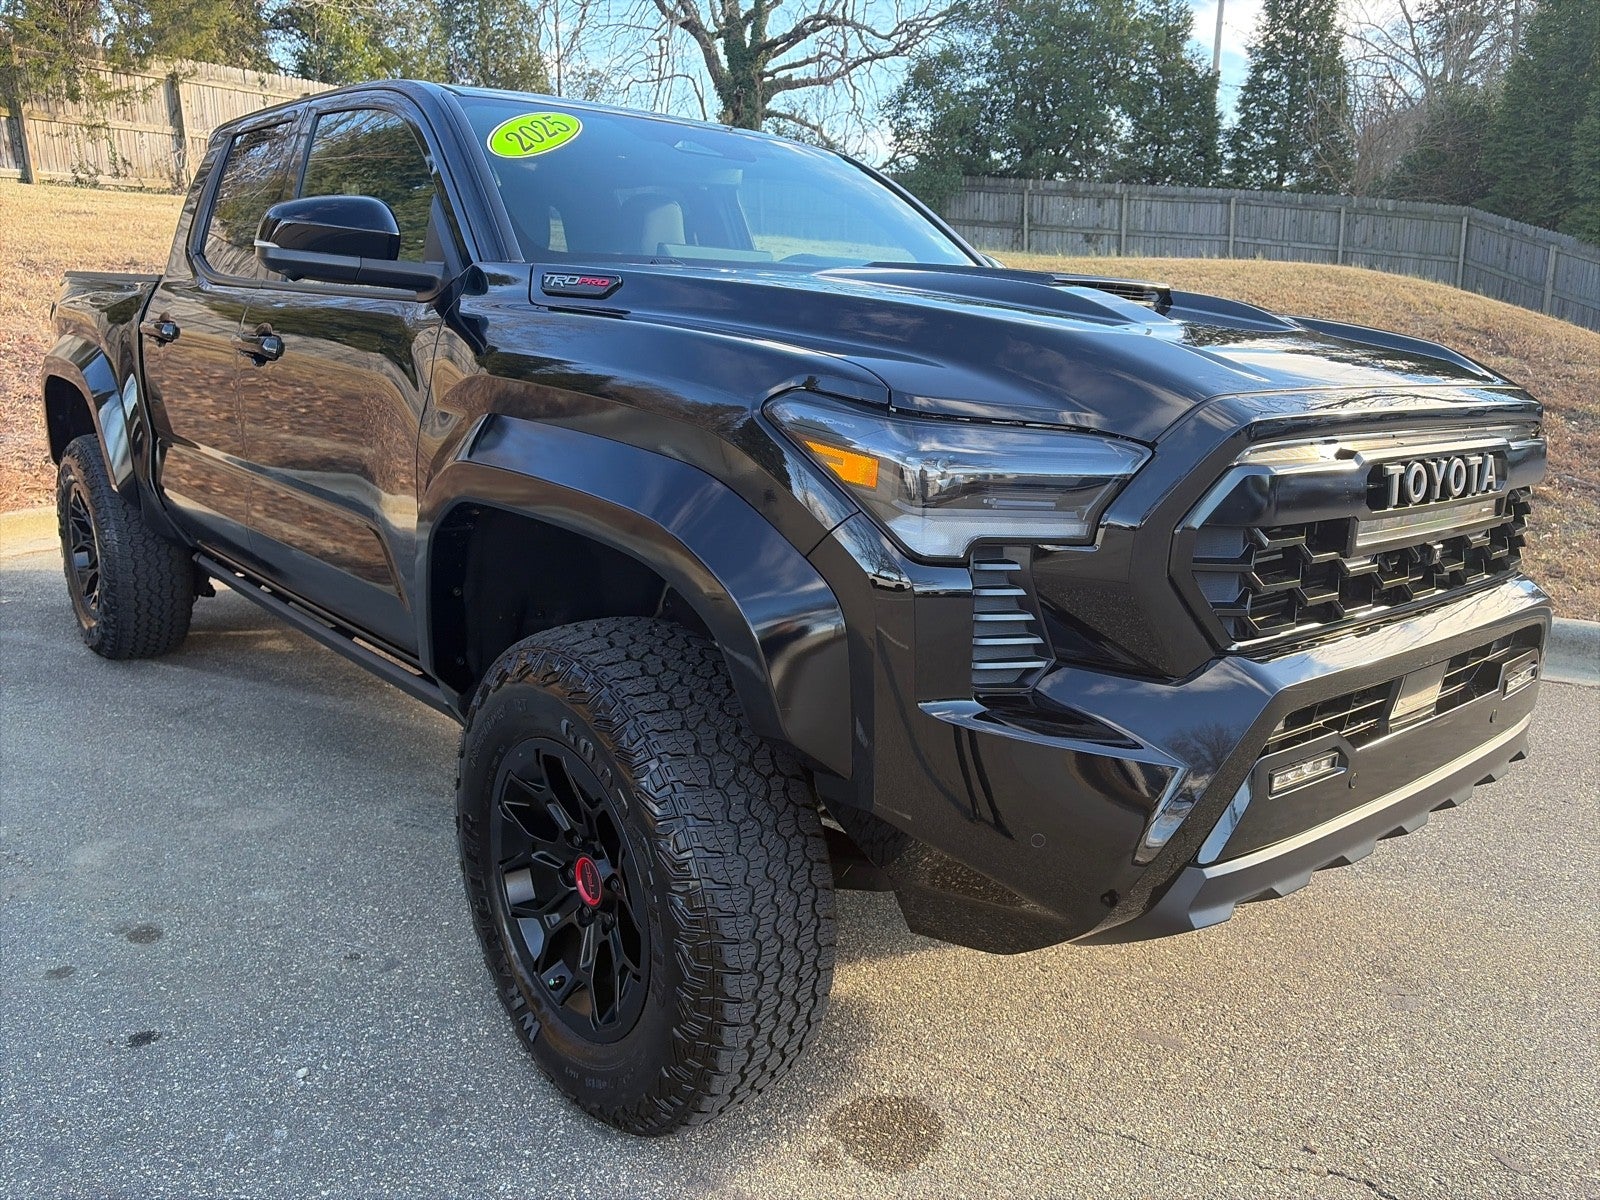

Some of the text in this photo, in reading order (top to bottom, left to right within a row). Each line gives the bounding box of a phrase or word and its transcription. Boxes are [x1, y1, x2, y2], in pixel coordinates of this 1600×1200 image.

[505, 115, 571, 152] 2025
[1384, 453, 1497, 508] TOYOTA
[462, 812, 541, 1044] WRANGLER
